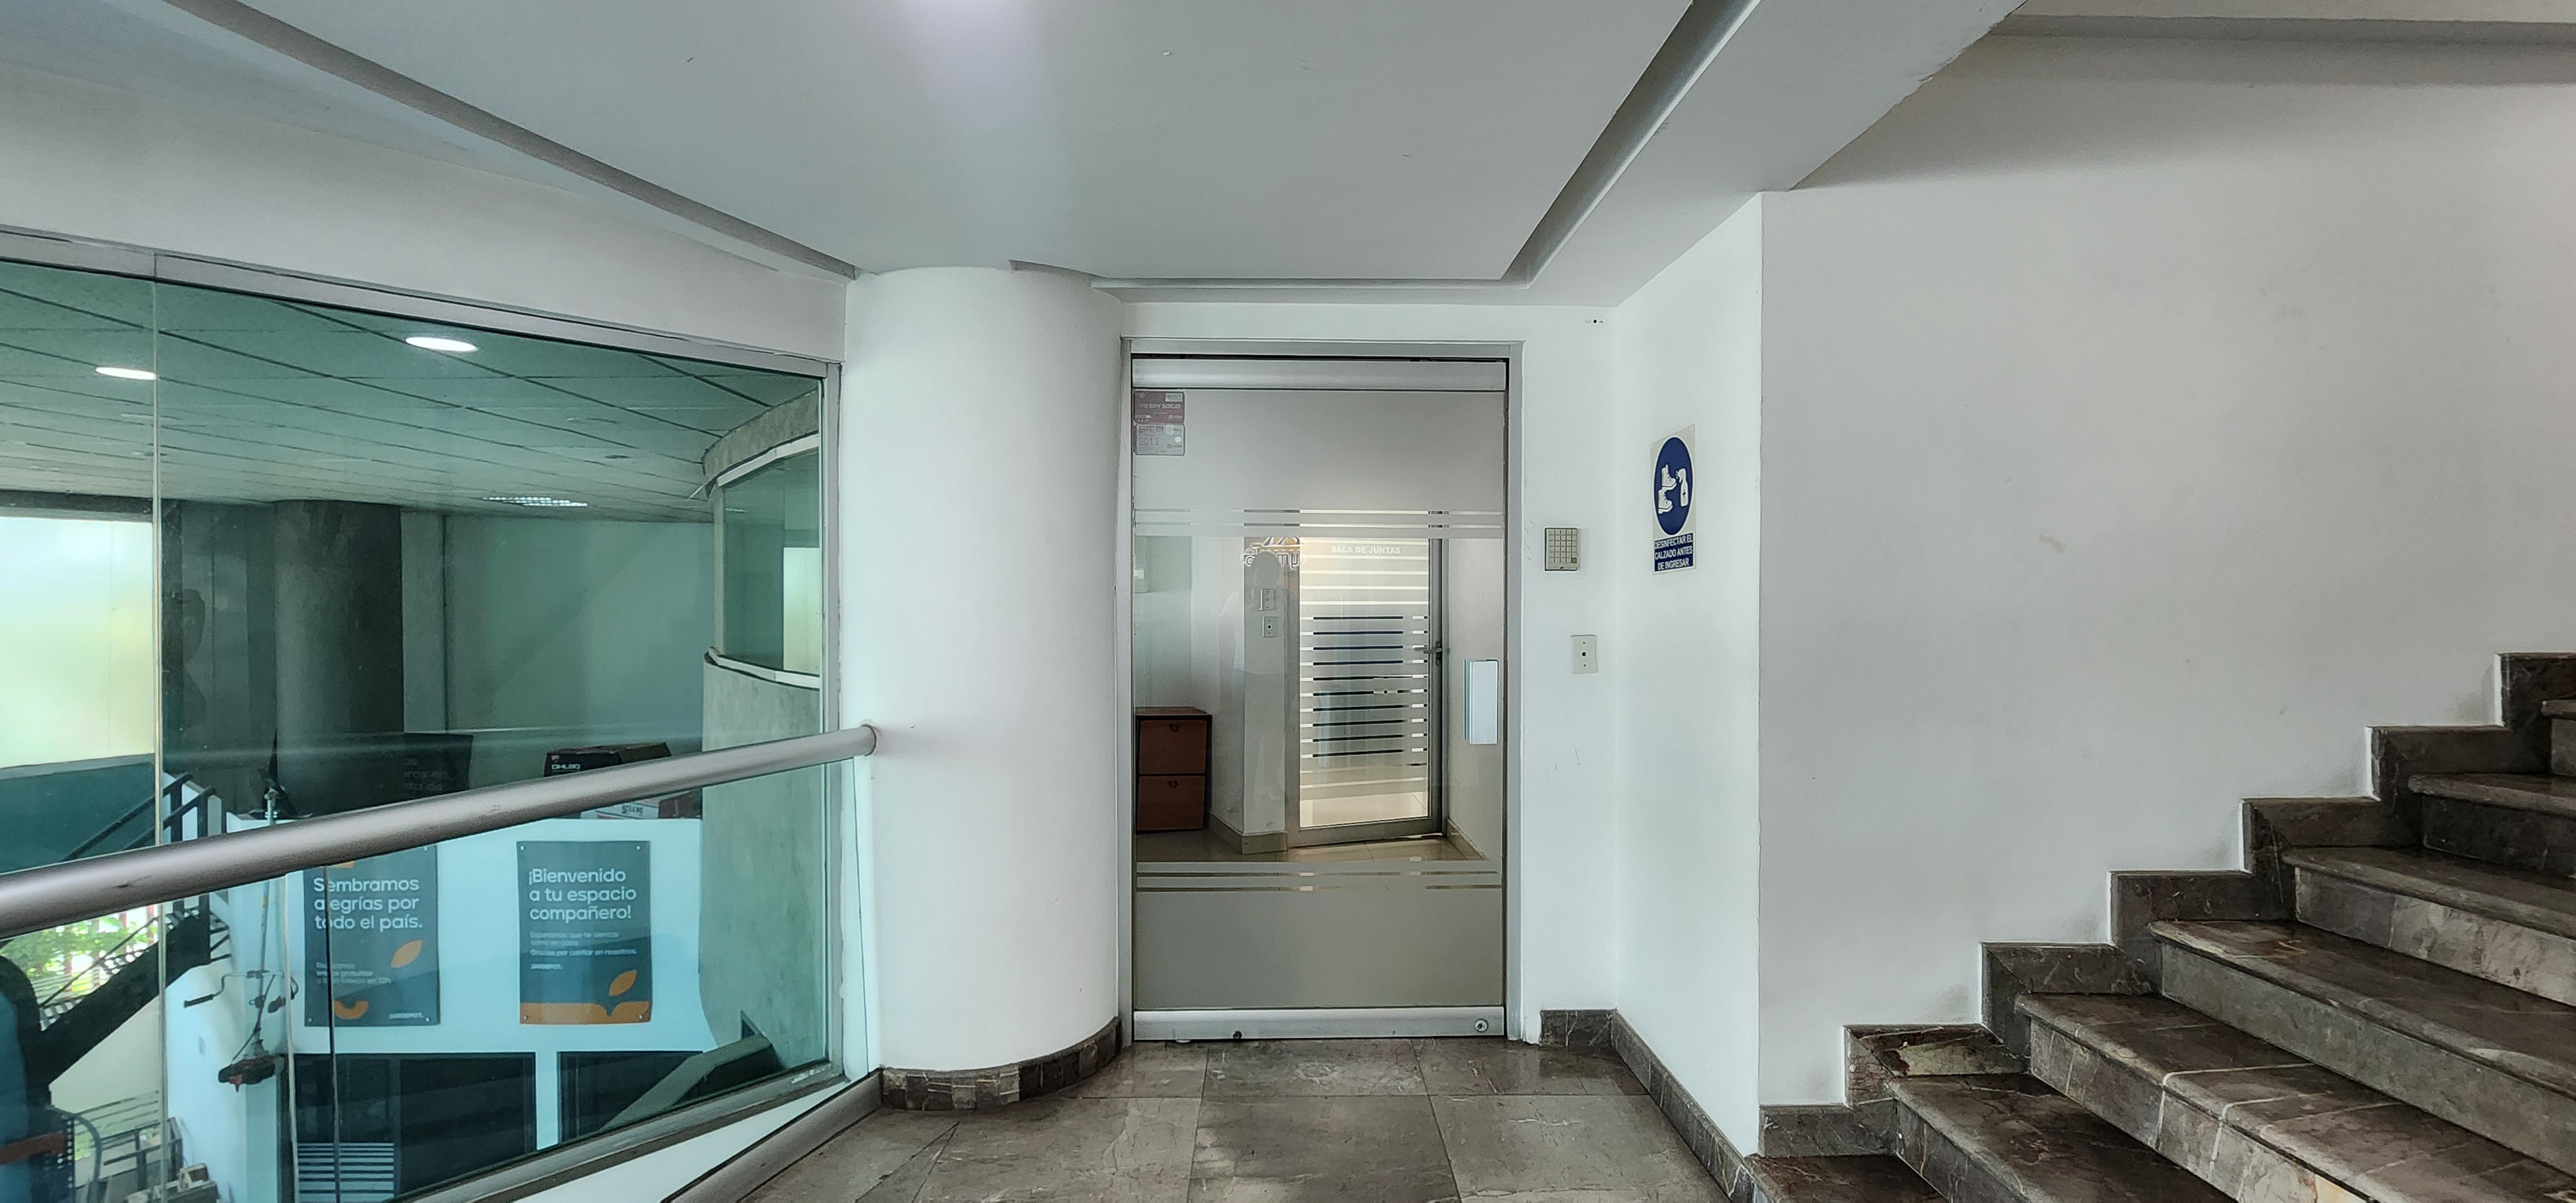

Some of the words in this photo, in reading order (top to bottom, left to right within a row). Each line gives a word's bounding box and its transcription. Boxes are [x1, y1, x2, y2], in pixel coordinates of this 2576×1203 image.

[1654, 536, 1686, 549] DESINFECTAR
[1687, 535, 1693, 543] EL
[1654, 549, 1676, 560] CALZADO
[1677, 545, 1692, 556] ANTES
[1658, 562, 1665, 570] DE
[1665, 558, 1689, 569] INGRESAR
[314, 877, 419, 892] Sembramos
[529, 867, 626, 886] ¡Bienvenido
[529, 890, 540, 901] a
[544, 888, 562, 901] tu
[567, 886, 636, 905] espacio
[314, 896, 383, 914] aegrías
[388, 898, 419, 913] por
[360, 914, 374, 929] el
[379, 914, 422, 933] país.
[529, 905, 631, 924] compañero!
